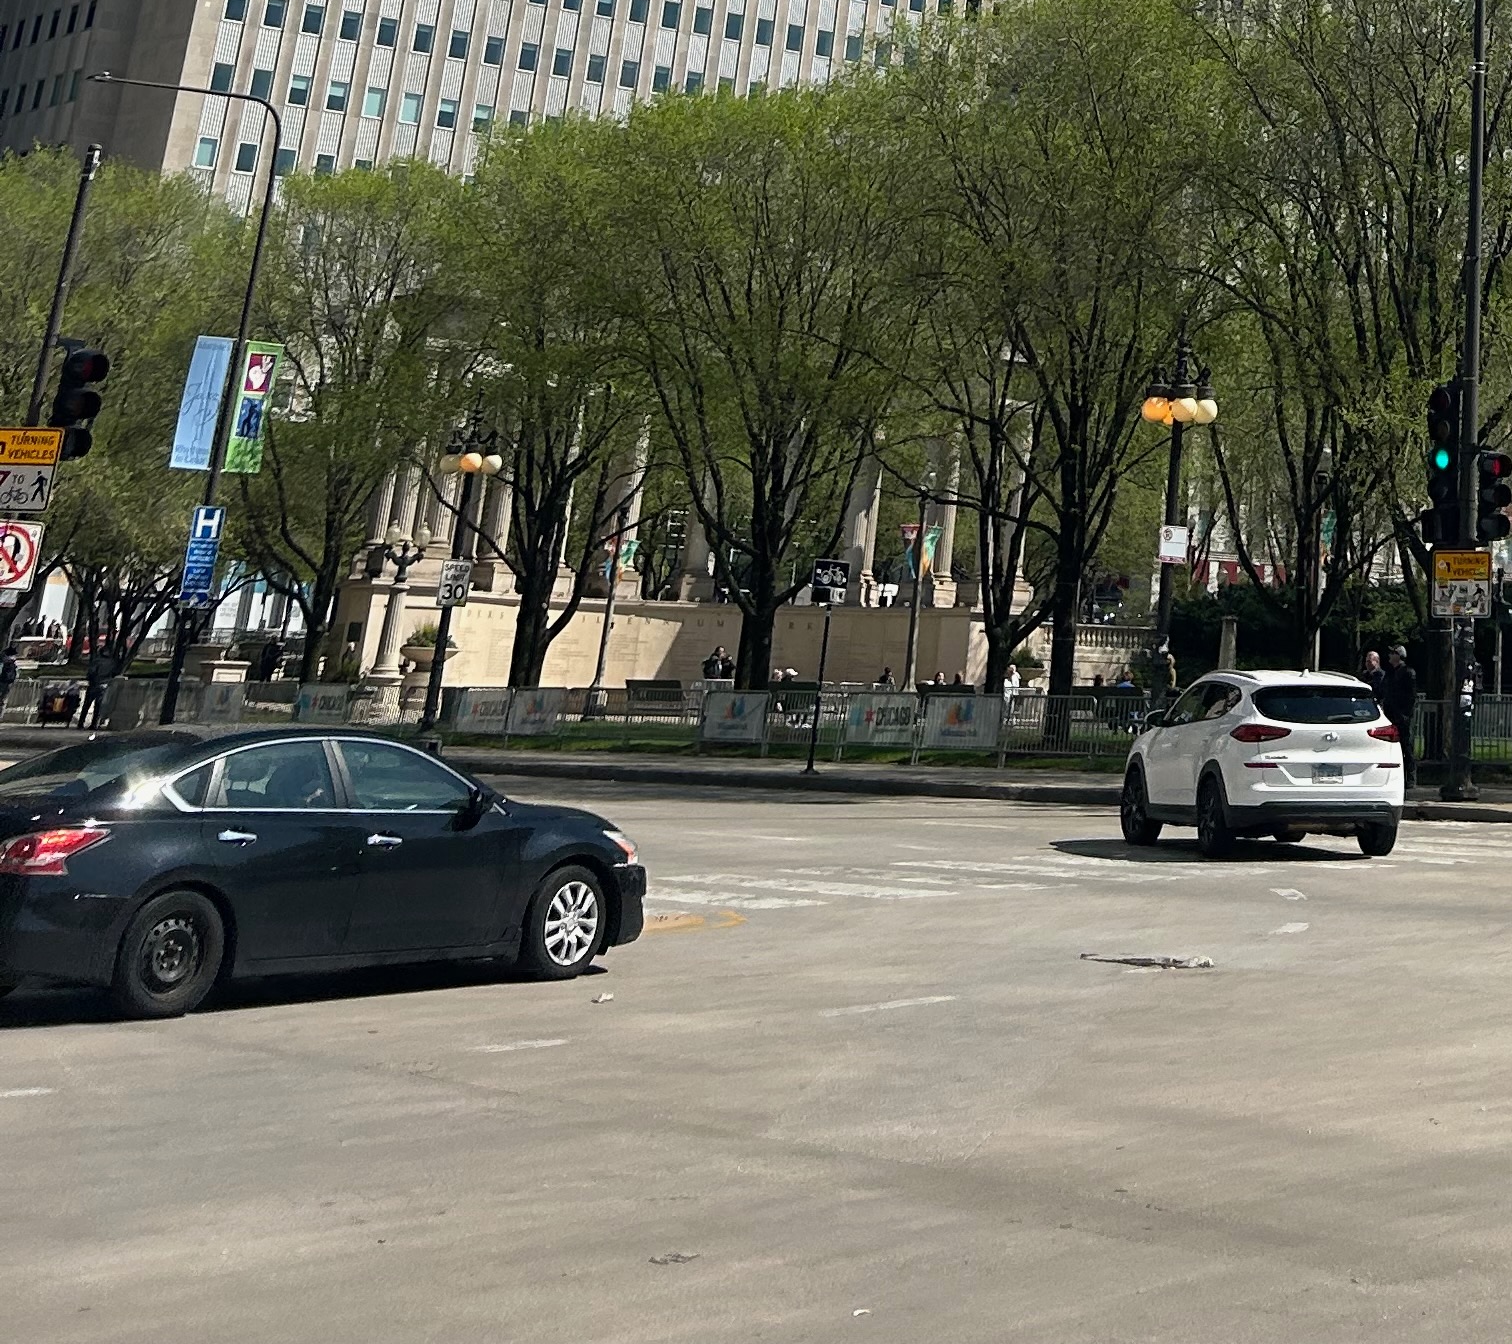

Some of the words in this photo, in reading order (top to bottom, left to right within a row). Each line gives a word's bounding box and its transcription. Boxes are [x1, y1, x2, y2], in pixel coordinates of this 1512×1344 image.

[11, 434, 55, 446] TURNING
[8, 448, 55, 460] VEHICLES
[12, 473, 25, 485] TO
[195, 508, 222, 538] H
[444, 563, 470, 573] SPEED
[441, 583, 465, 600] 30
